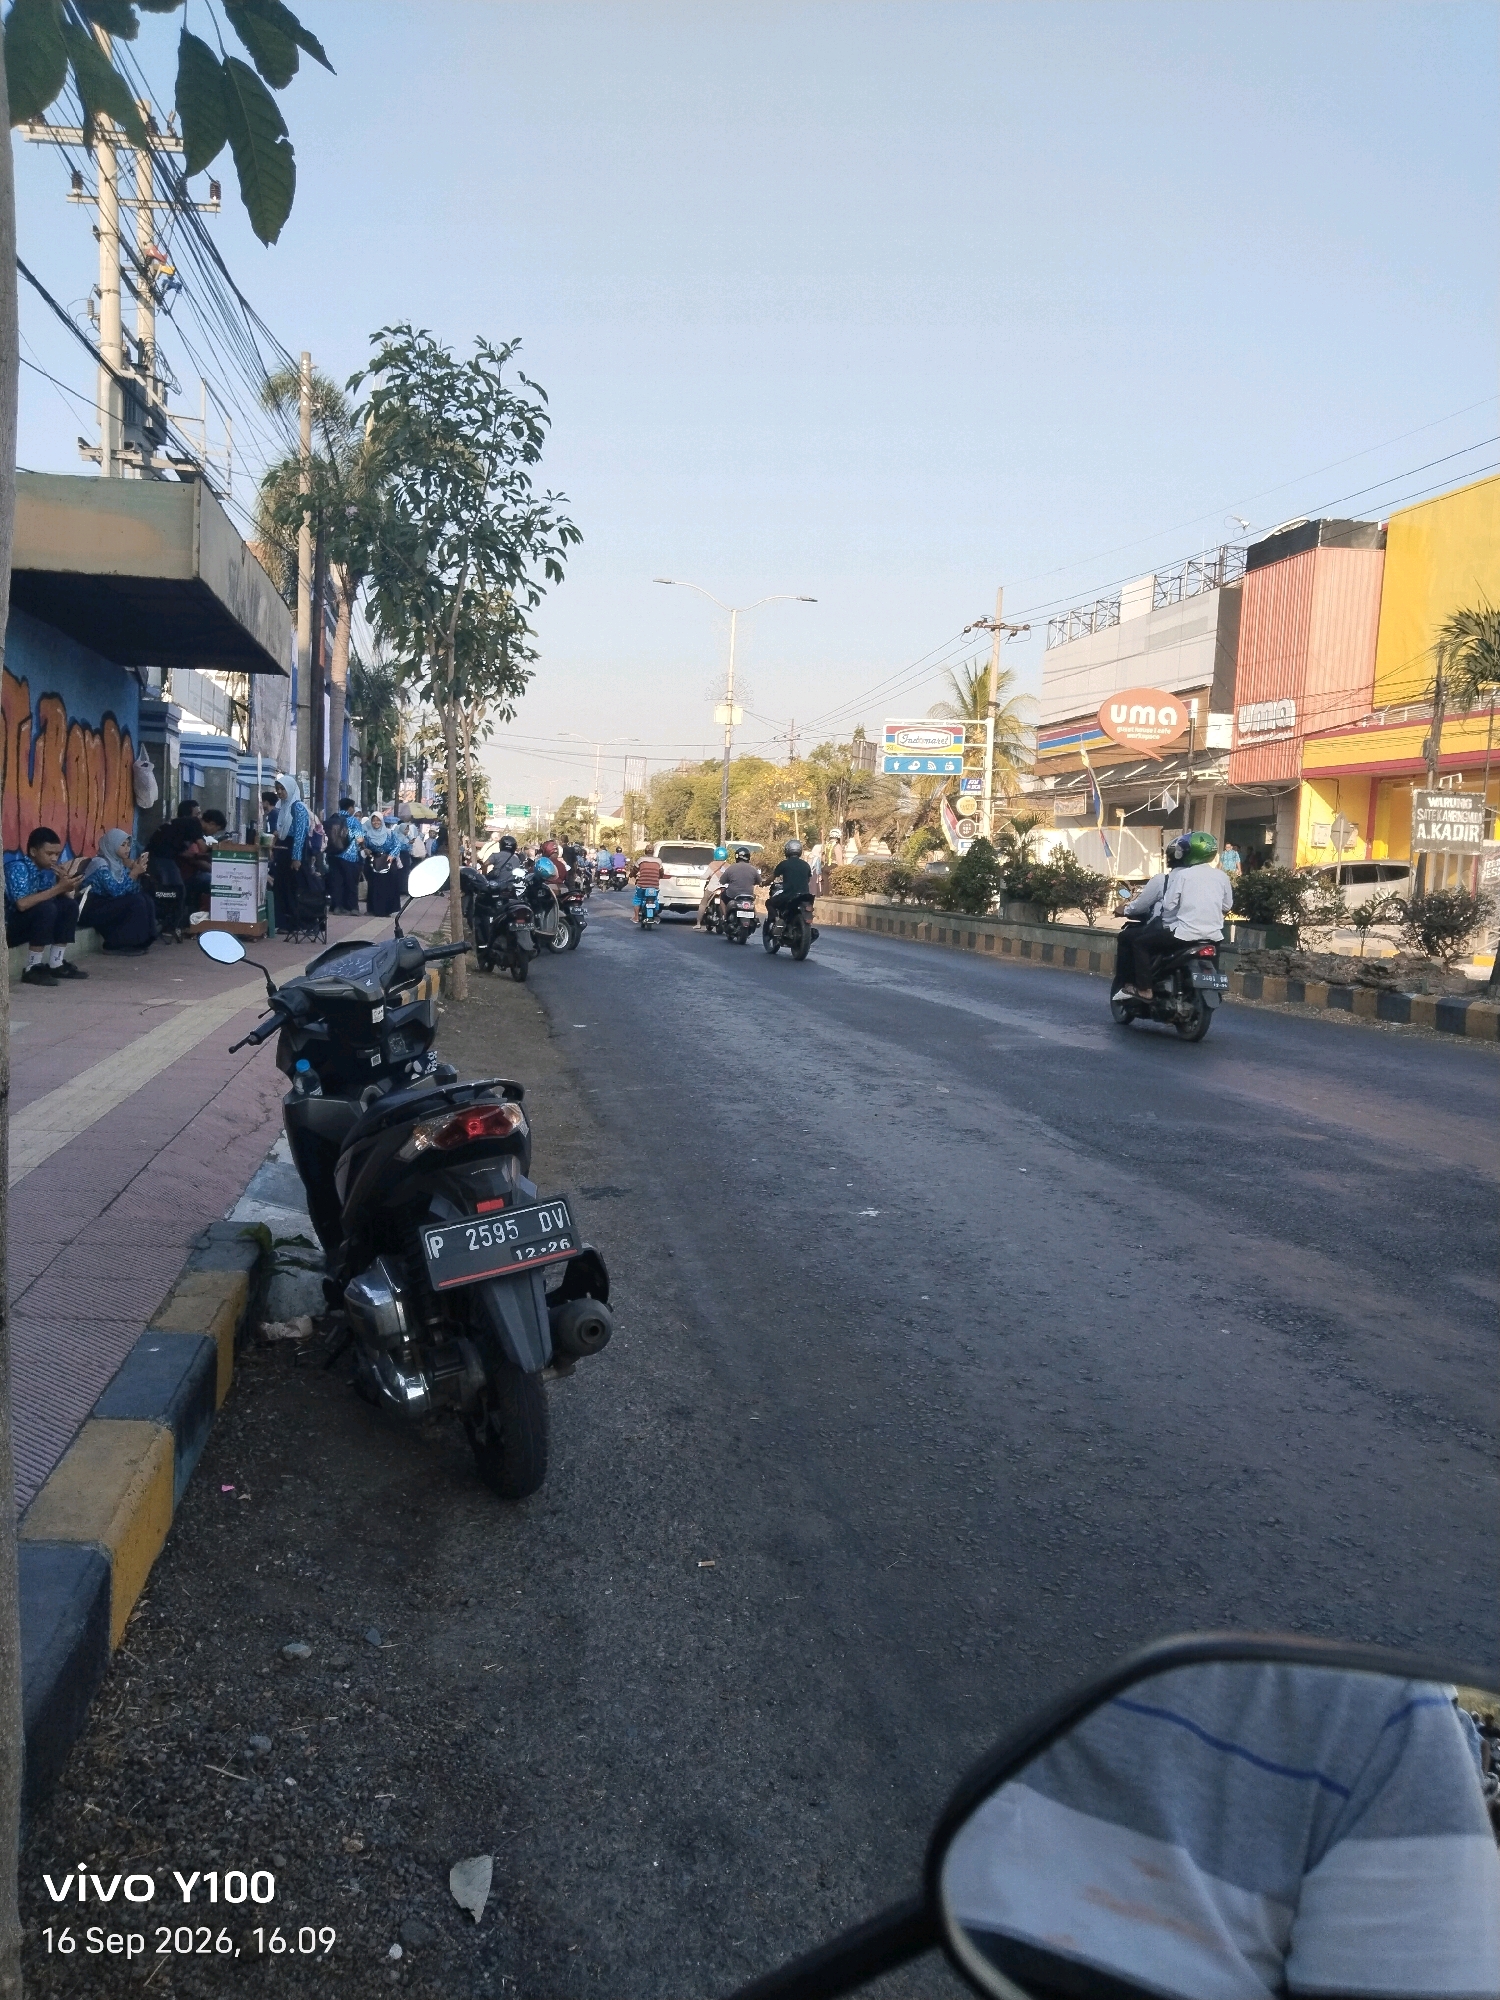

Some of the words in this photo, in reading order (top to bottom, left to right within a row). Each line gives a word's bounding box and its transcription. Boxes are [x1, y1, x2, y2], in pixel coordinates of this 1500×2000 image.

[1110, 704, 1178, 726] uma
[1238, 698, 1296, 733] uma
[900, 733, 949, 745] Indomaret
[1427, 796, 1472, 809] WARUNG
[429, 1236, 444, 1258] P
[466, 1219, 519, 1251] 2595
[538, 1208, 564, 1233] DV
